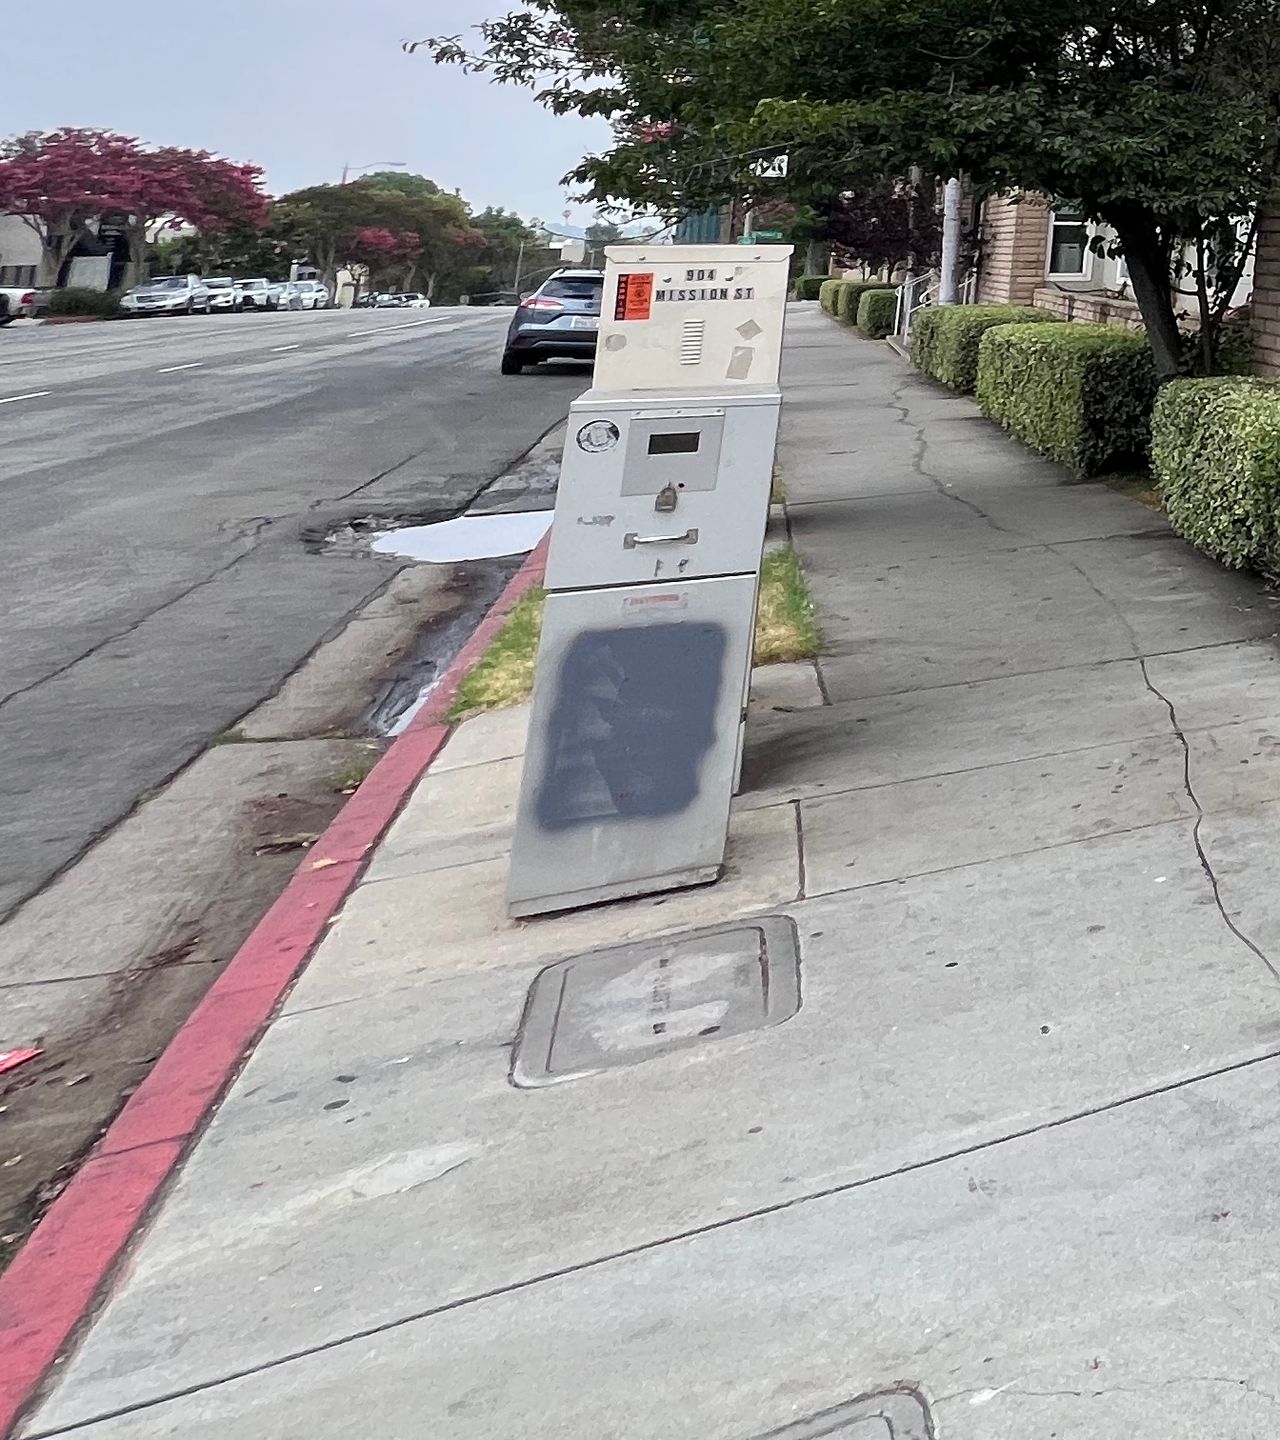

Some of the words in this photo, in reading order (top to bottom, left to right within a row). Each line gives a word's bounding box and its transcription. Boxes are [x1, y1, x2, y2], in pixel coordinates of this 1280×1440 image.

[687, 270, 714, 281] 904
[656, 289, 728, 301] MISSION
[734, 288, 754, 299] ST
